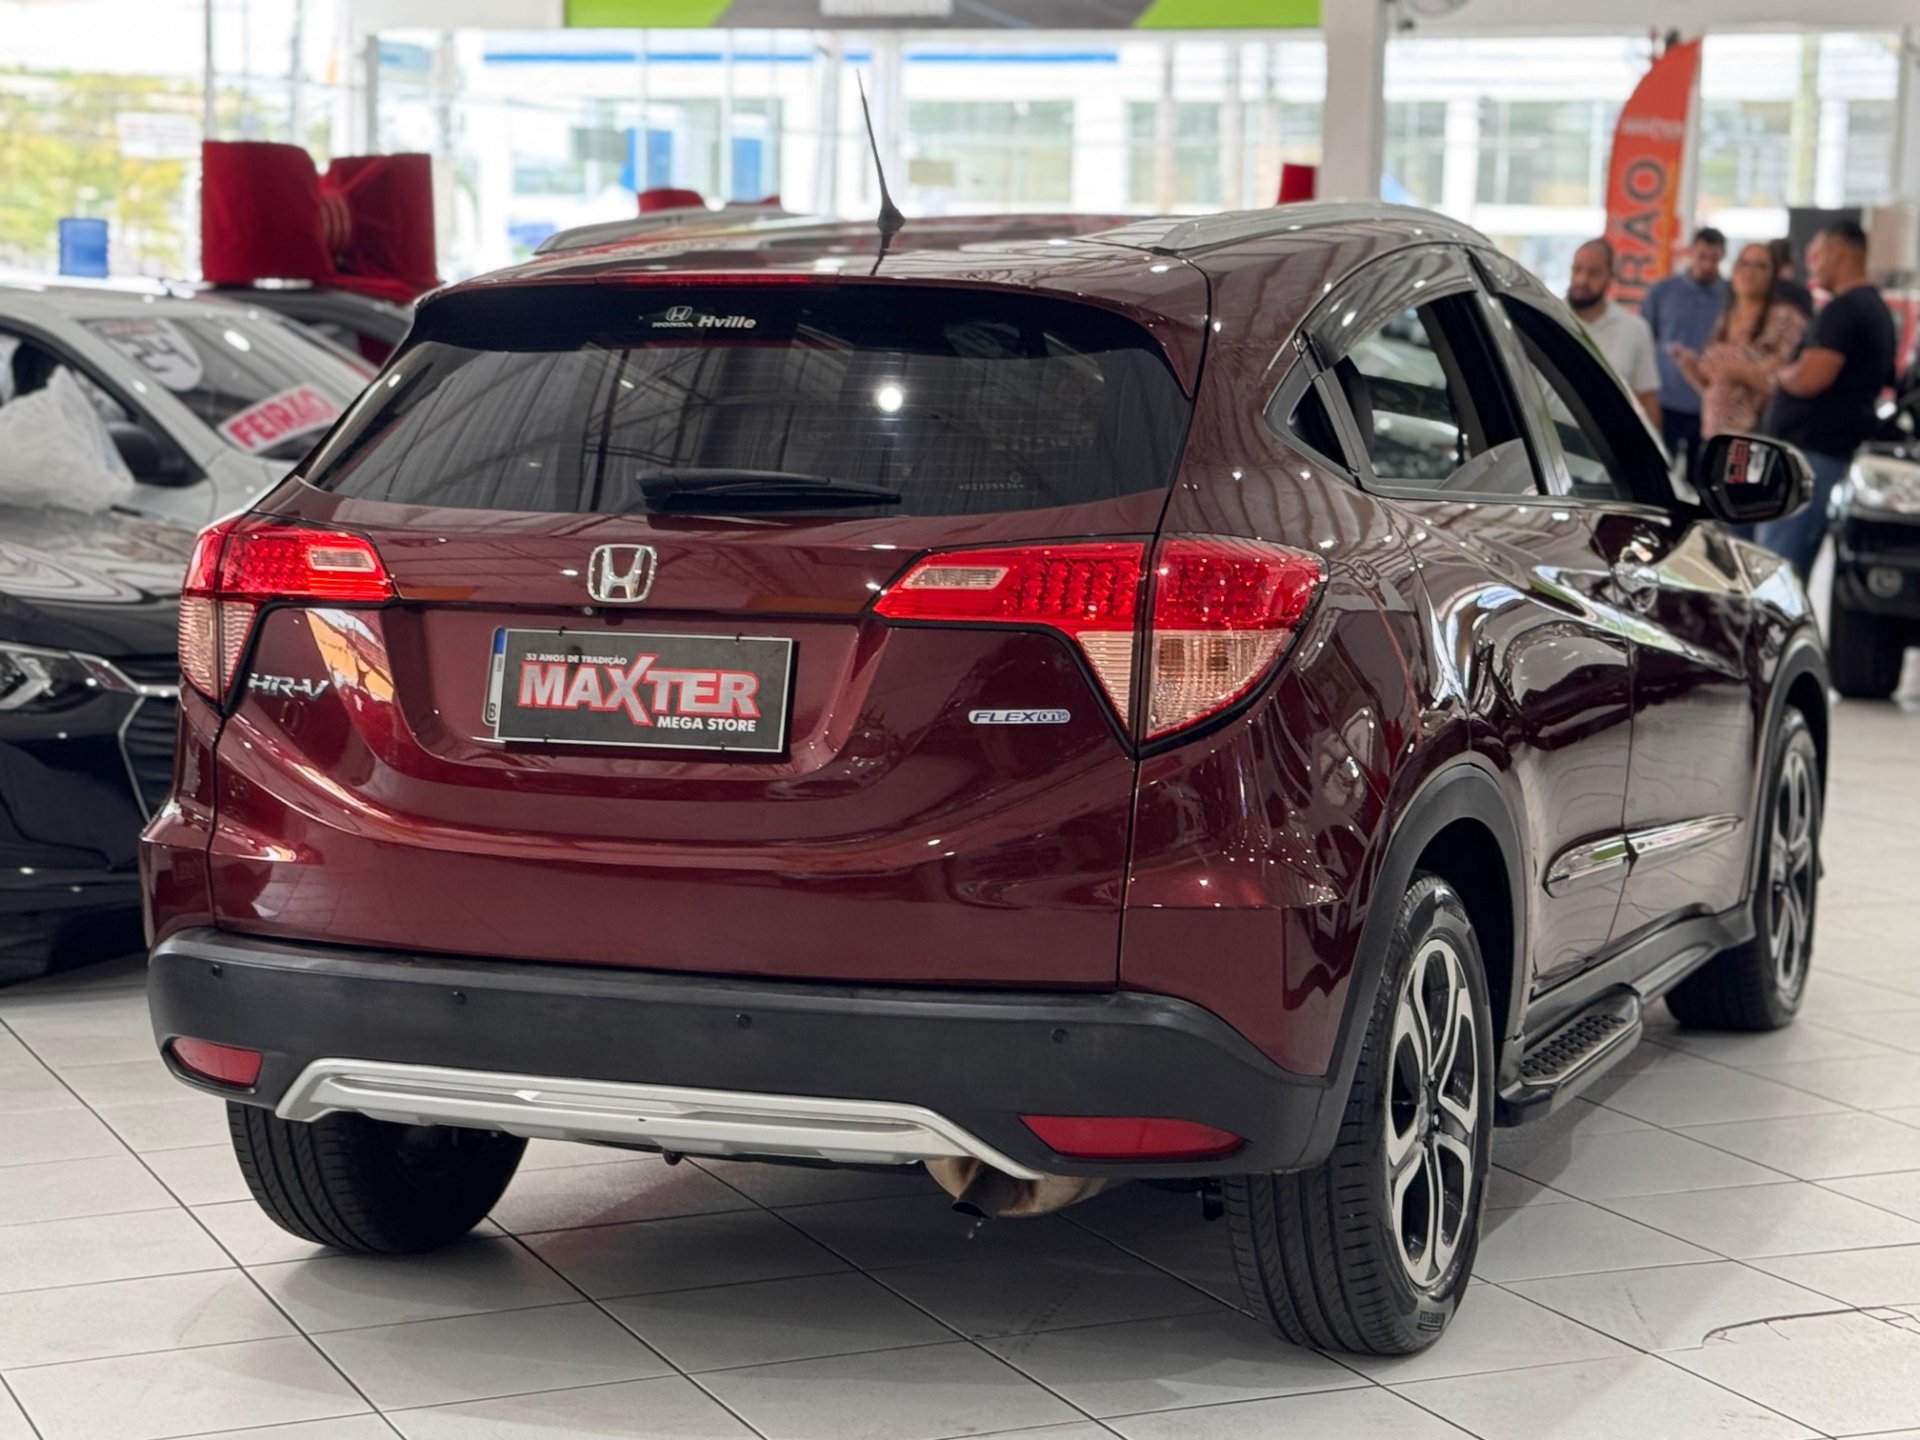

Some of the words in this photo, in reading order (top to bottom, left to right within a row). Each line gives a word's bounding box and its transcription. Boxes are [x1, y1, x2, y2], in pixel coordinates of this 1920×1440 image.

[698, 315, 757, 329] Hville
[538, 653, 566, 663] ANOS
[567, 655, 580, 664] DE
[580, 655, 628, 667] TRADIÇÃO
[247, 672, 330, 698] HR-V
[518, 652, 761, 727] MAXTER
[656, 715, 704, 731] MEGA
[707, 718, 757, 733] STORE
